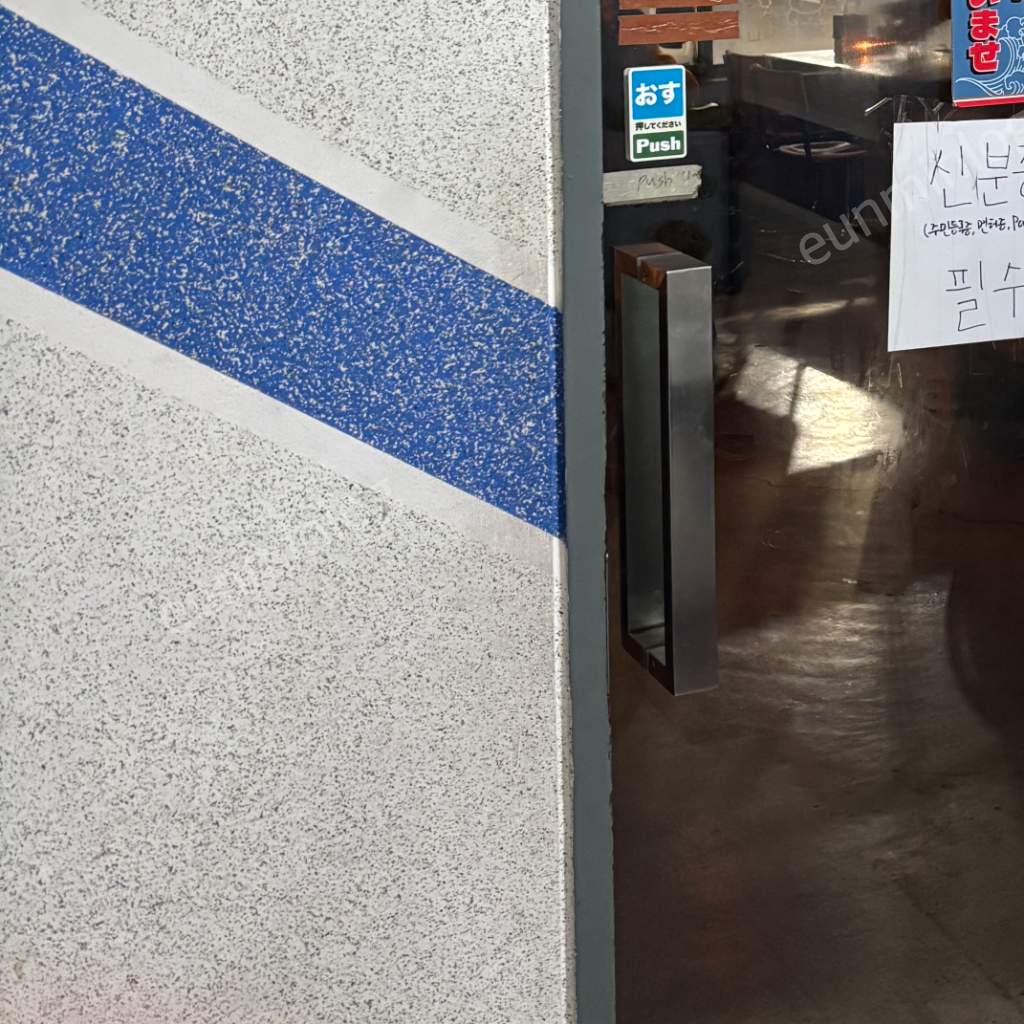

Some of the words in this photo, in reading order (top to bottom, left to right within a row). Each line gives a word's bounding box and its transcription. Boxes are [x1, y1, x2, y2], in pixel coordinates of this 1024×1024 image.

[635, 81, 681, 107] おす
[635, 120, 682, 131] 押してください
[636, 136, 681, 154] Push
